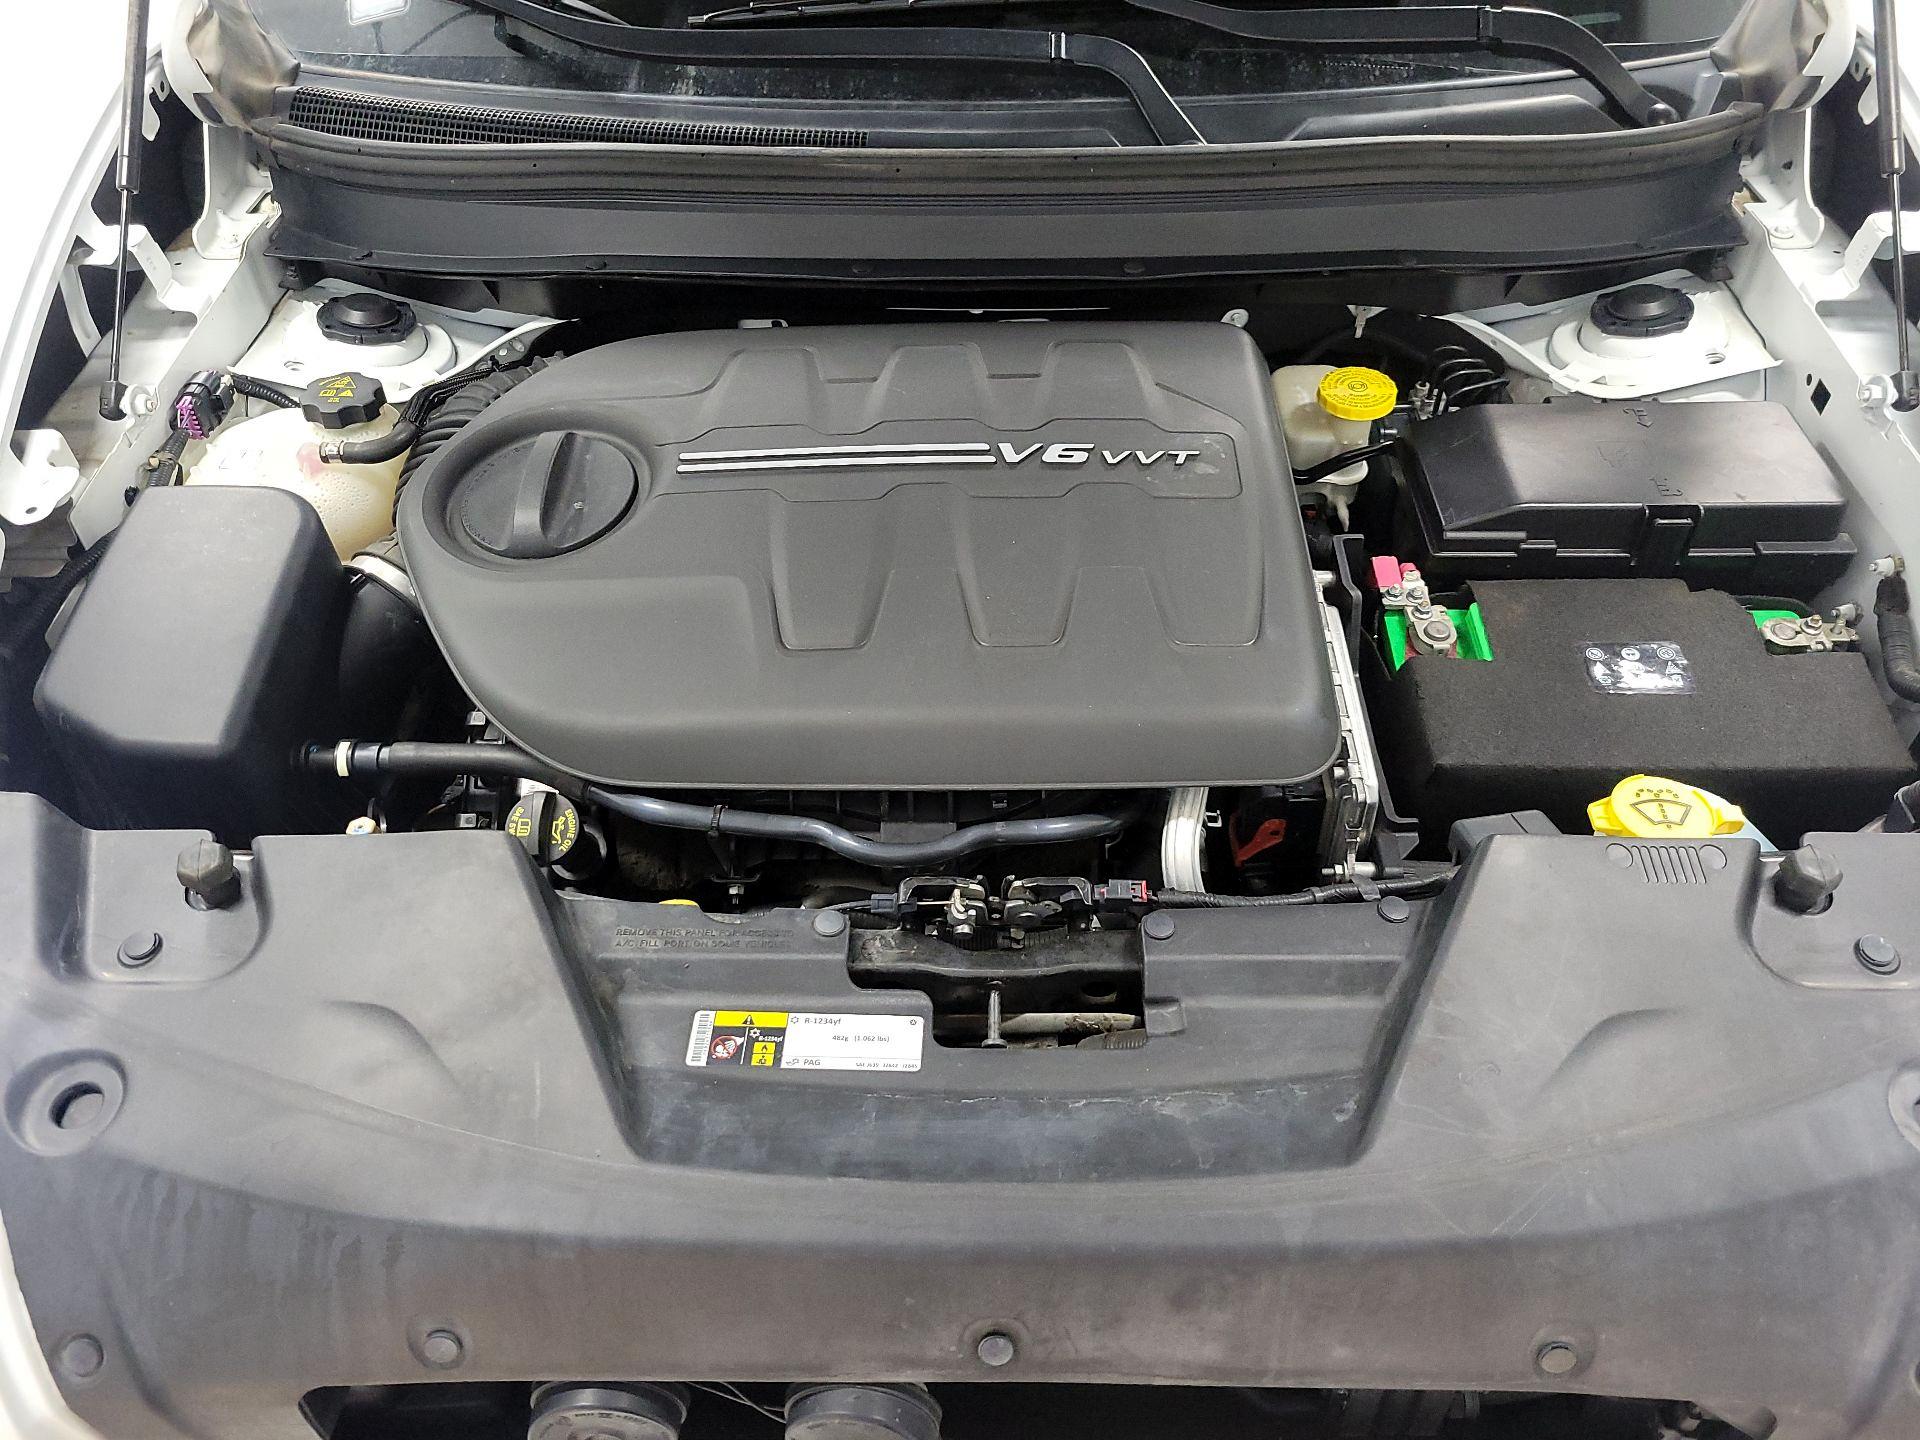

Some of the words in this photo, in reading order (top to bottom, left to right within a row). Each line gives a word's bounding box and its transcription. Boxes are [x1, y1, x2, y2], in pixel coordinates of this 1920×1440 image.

[997, 443, 1095, 464] V6
[1101, 450, 1200, 465] VVT
[511, 806, 525, 823] SAE
[564, 808, 576, 839] ENGINE
[558, 839, 572, 852] OIL
[615, 928, 657, 937] REMOVE
[660, 928, 682, 937] THIS
[684, 929, 716, 938] PANEL
[615, 939, 634, 948] A/C
[639, 939, 659, 948] FILL
[663, 939, 689, 948] PORT
[693, 939, 709, 949] ON
[804, 1016, 841, 1026] R-1234yf
[832, 1035, 849, 1043] 482g
[803, 1058, 821, 1066] PAG
